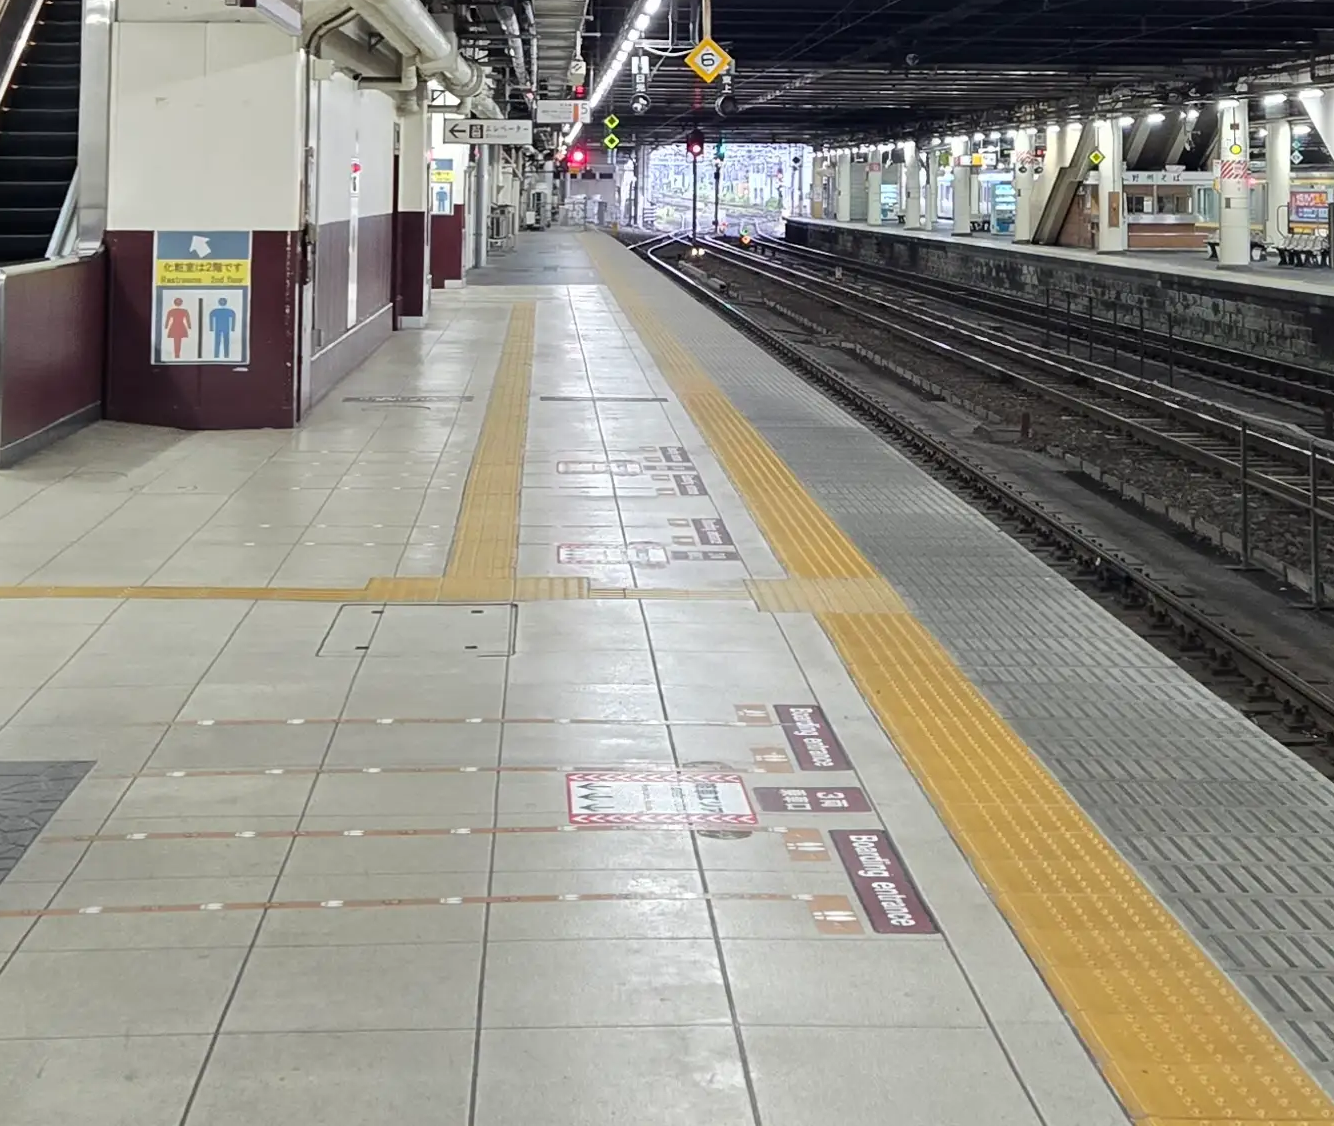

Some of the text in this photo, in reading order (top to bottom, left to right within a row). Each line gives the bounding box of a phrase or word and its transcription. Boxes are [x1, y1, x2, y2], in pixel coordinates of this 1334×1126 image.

[701, 52, 715, 67] 6
[848, 834, 916, 928] Boarding entrance
